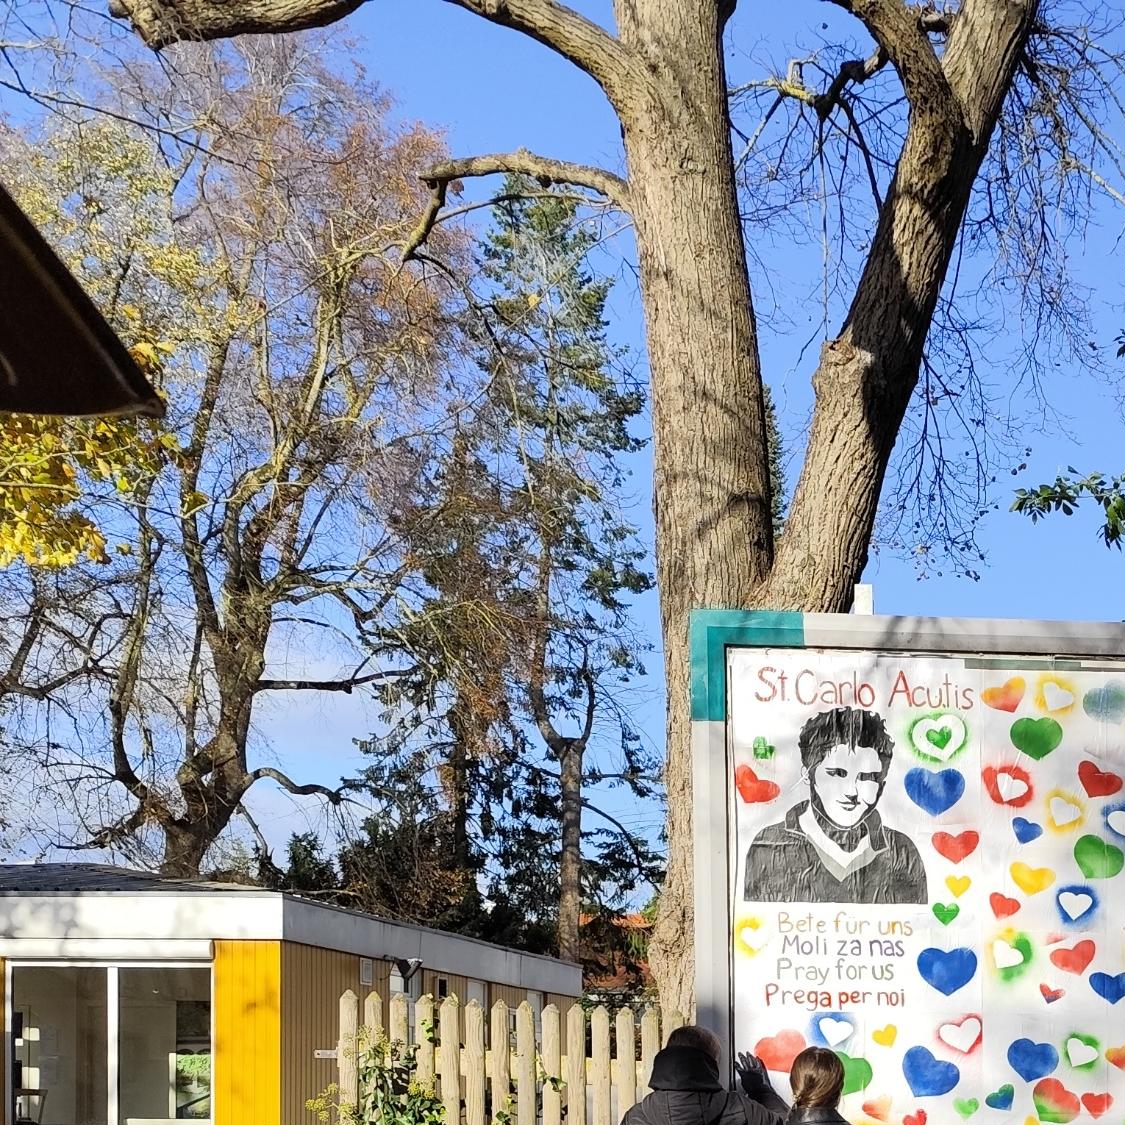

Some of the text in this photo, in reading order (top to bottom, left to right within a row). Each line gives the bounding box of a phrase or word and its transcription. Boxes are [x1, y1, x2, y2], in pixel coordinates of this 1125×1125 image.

[795, 669, 876, 708] Carlo
[778, 911, 826, 933] Bete
[878, 919, 913, 937] uns
[781, 934, 905, 957] Moli za nas
[776, 957, 895, 986] Pray for us
[765, 982, 905, 1012] Prega per noi
